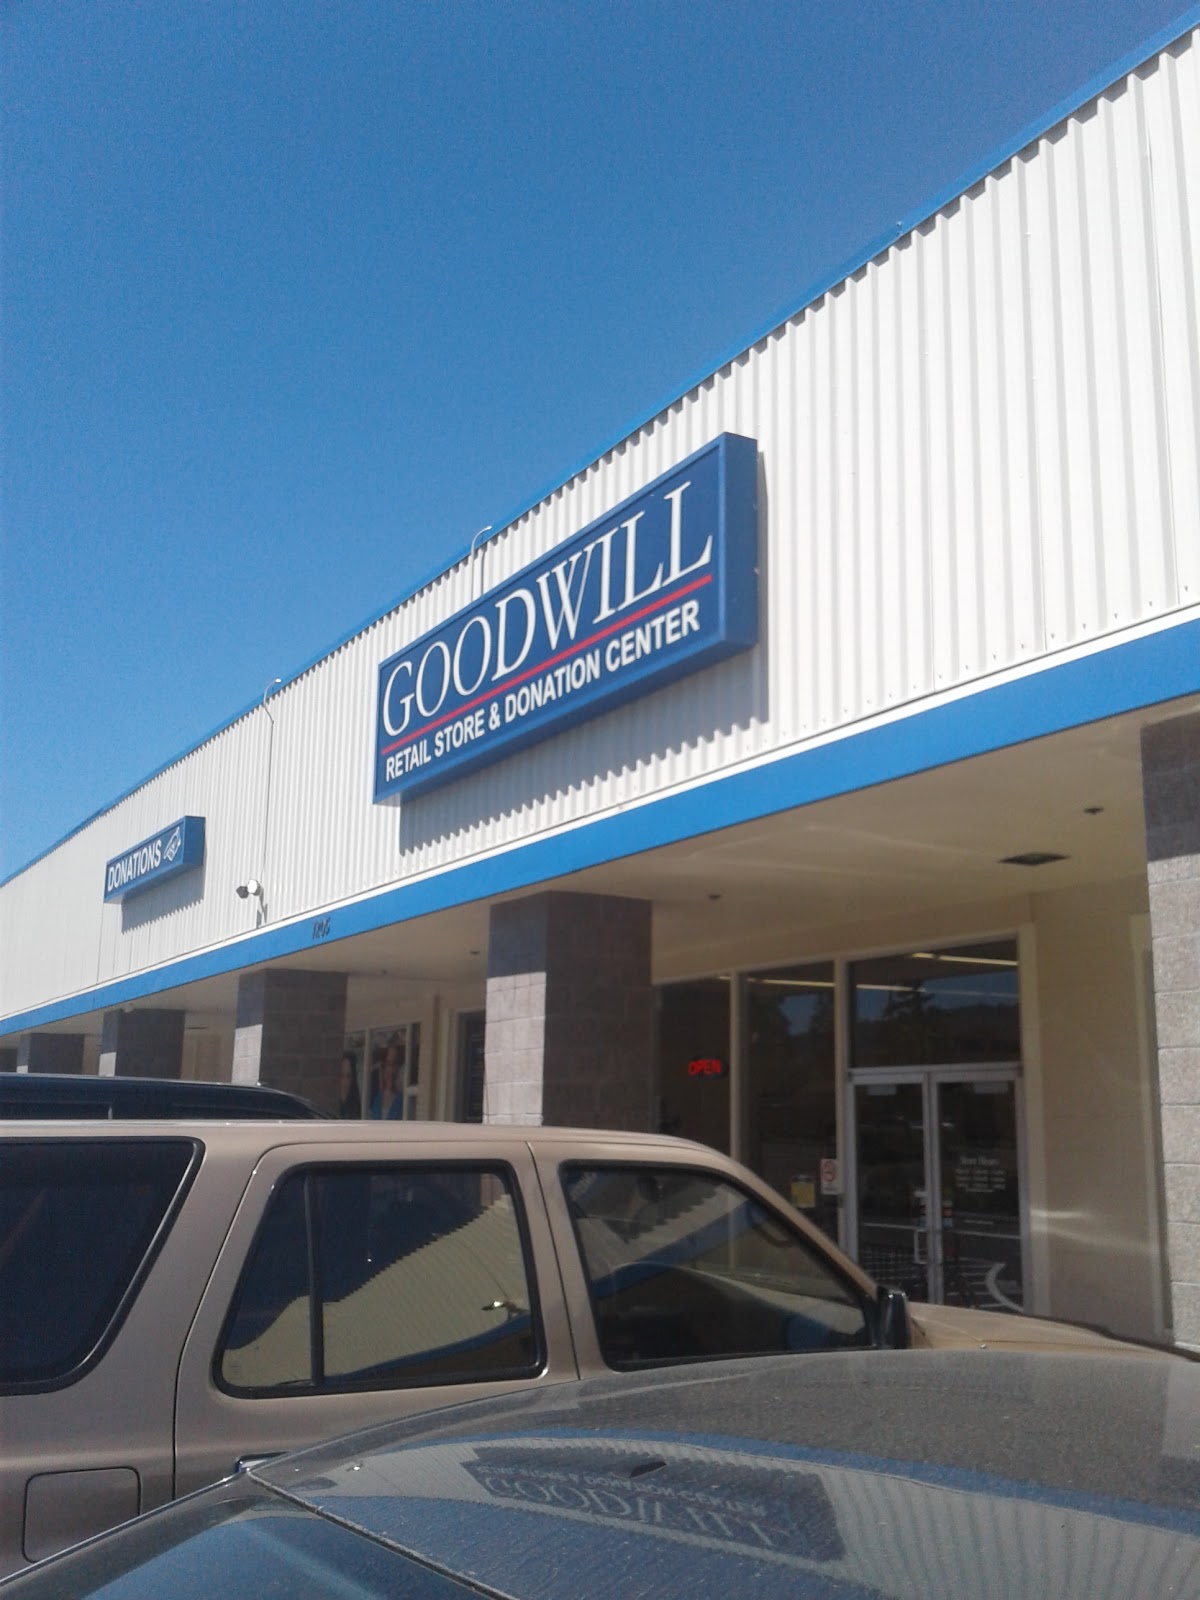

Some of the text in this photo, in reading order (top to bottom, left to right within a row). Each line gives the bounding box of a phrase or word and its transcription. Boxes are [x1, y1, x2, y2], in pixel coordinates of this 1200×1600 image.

[382, 481, 713, 737] GOODWILL
[386, 599, 700, 782] RETAIL STORE & DONATION CENTER
[107, 839, 162, 892] DONATIONS
[688, 1059, 722, 1075] OPEN
